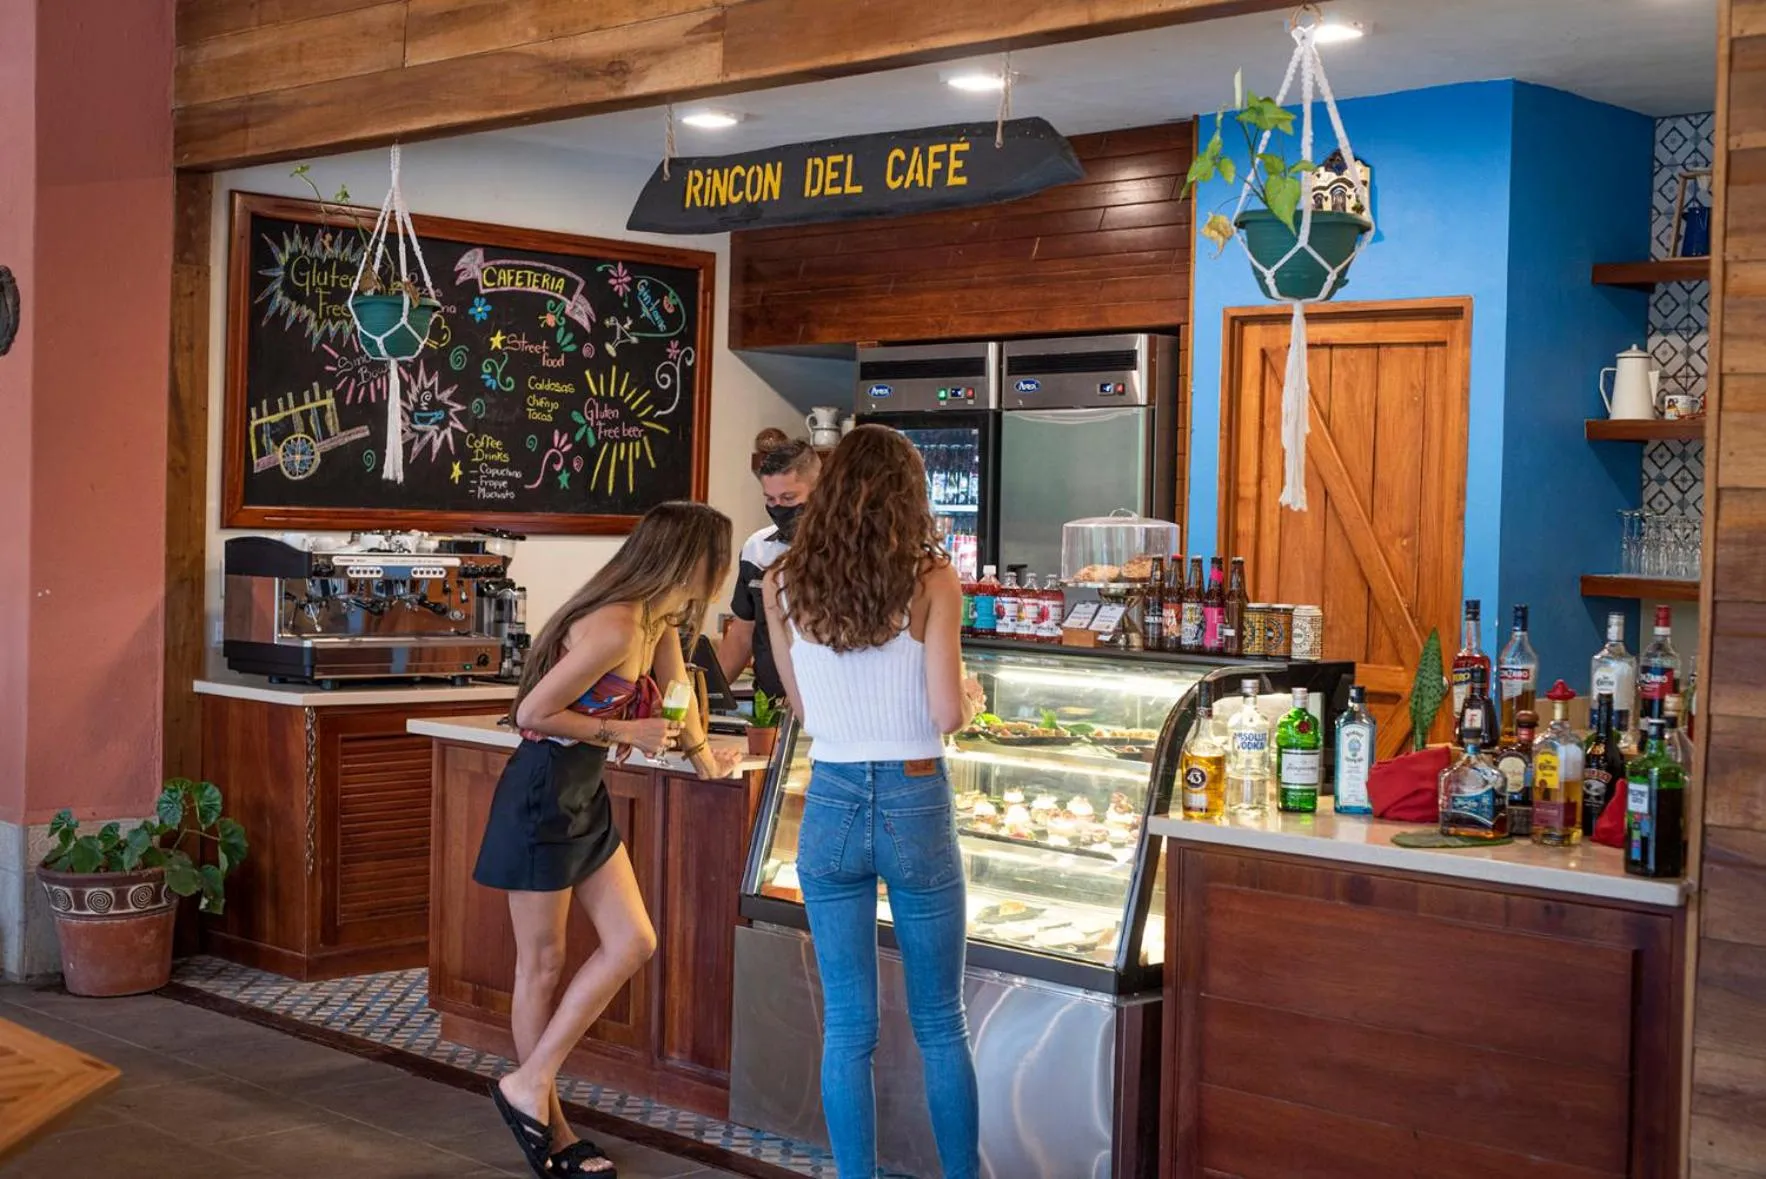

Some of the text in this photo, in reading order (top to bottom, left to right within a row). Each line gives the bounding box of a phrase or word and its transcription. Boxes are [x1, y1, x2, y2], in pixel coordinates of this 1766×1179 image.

[804, 153, 863, 198] DEL
[886, 137, 971, 190] CAFÉ
[482, 266, 566, 295] CAFETERIA
[503, 332, 550, 353] Street
[526, 408, 553, 422] Tacos
[584, 397, 620, 427] Gluten
[594, 421, 645, 441] Free beer
[465, 433, 503, 450] Coffee
[471, 448, 511, 463] Drinks
